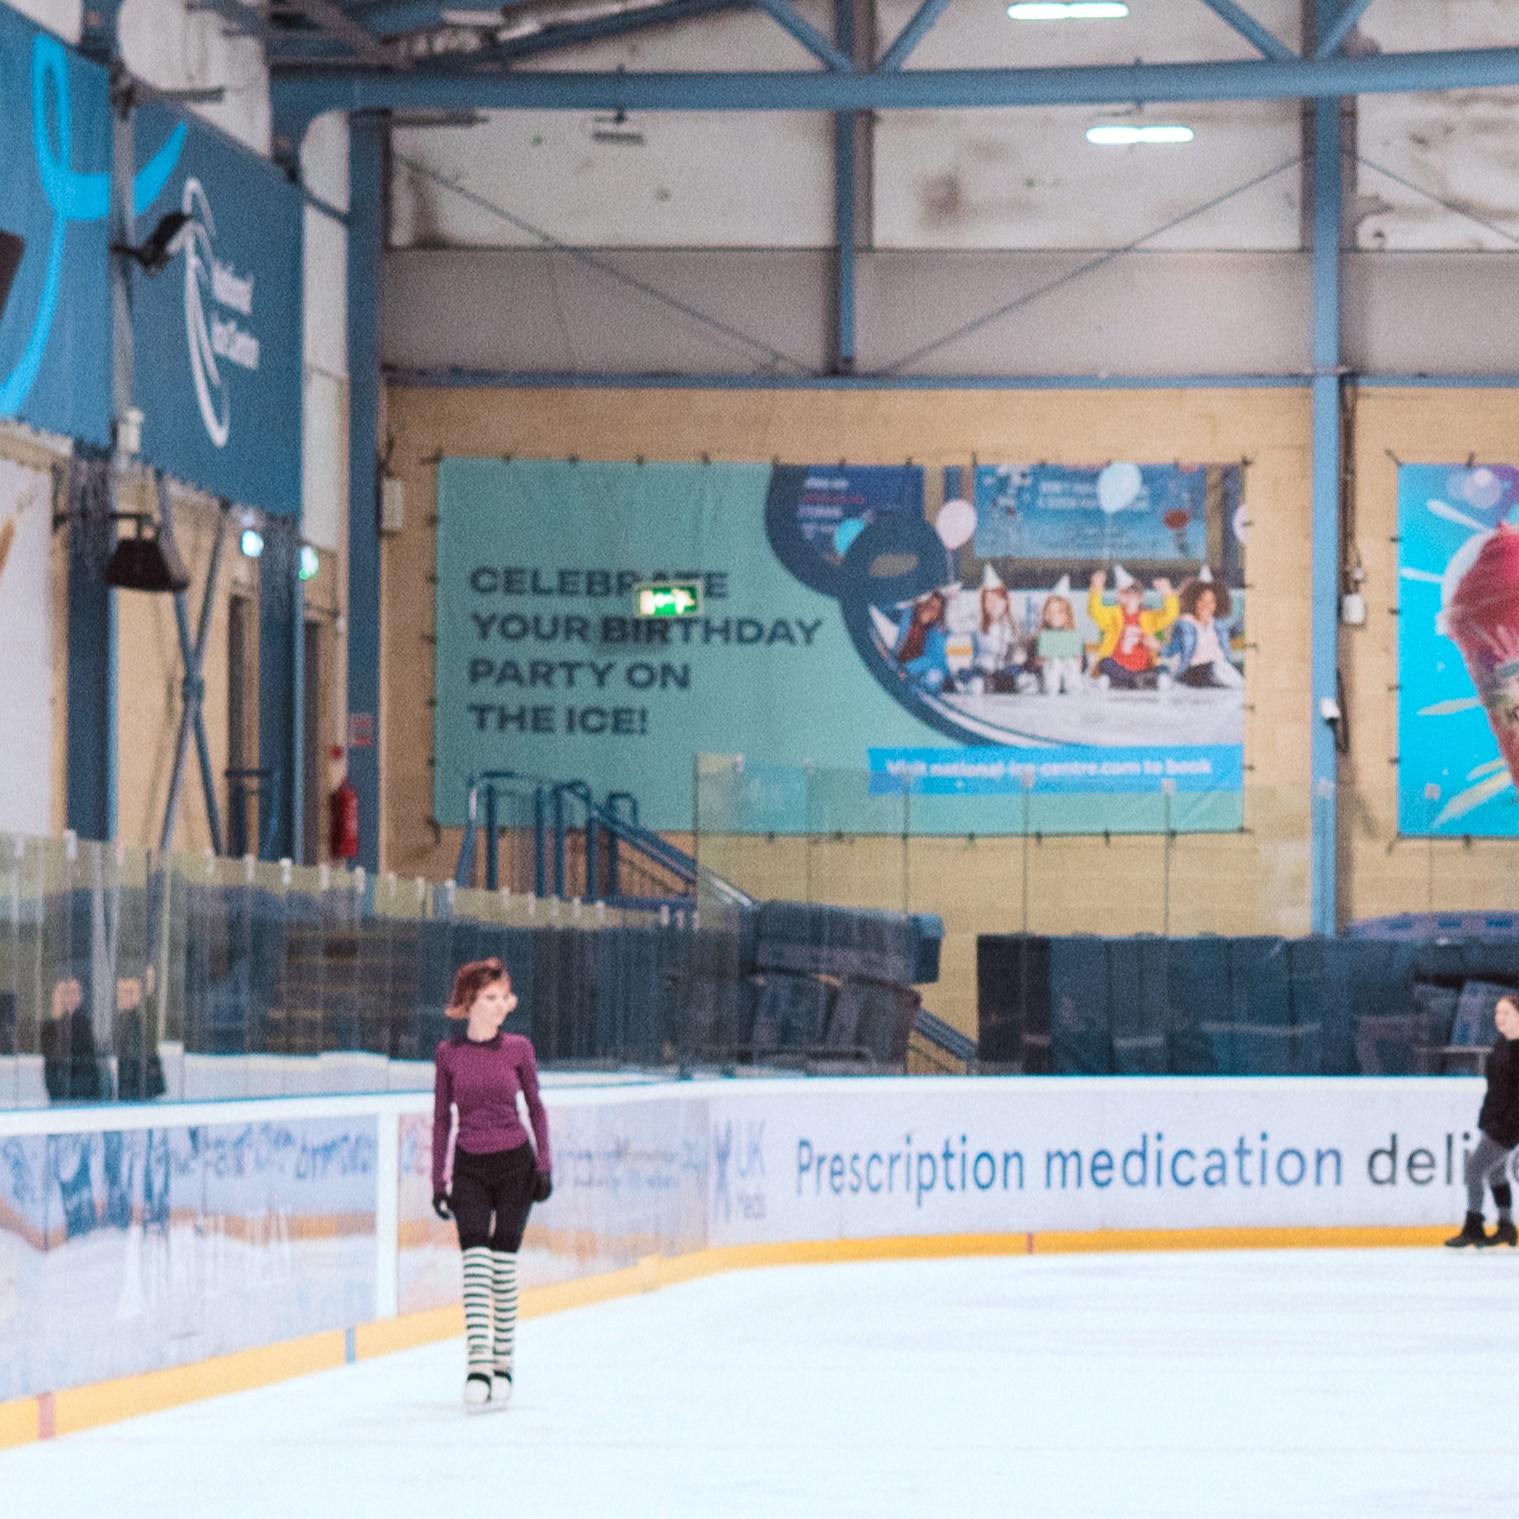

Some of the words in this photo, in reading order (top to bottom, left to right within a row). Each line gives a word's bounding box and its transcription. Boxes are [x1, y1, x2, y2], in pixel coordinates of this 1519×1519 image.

[471, 613, 590, 642] YOUR
[601, 617, 824, 646] BIRTHDAY
[468, 657, 615, 688] PARTY
[626, 661, 692, 690] ON
[467, 704, 556, 733] THE
[566, 706, 648, 735] ICE!
[797, 1133, 1025, 1209] Prescription
[1045, 1131, 1342, 1190] medication
